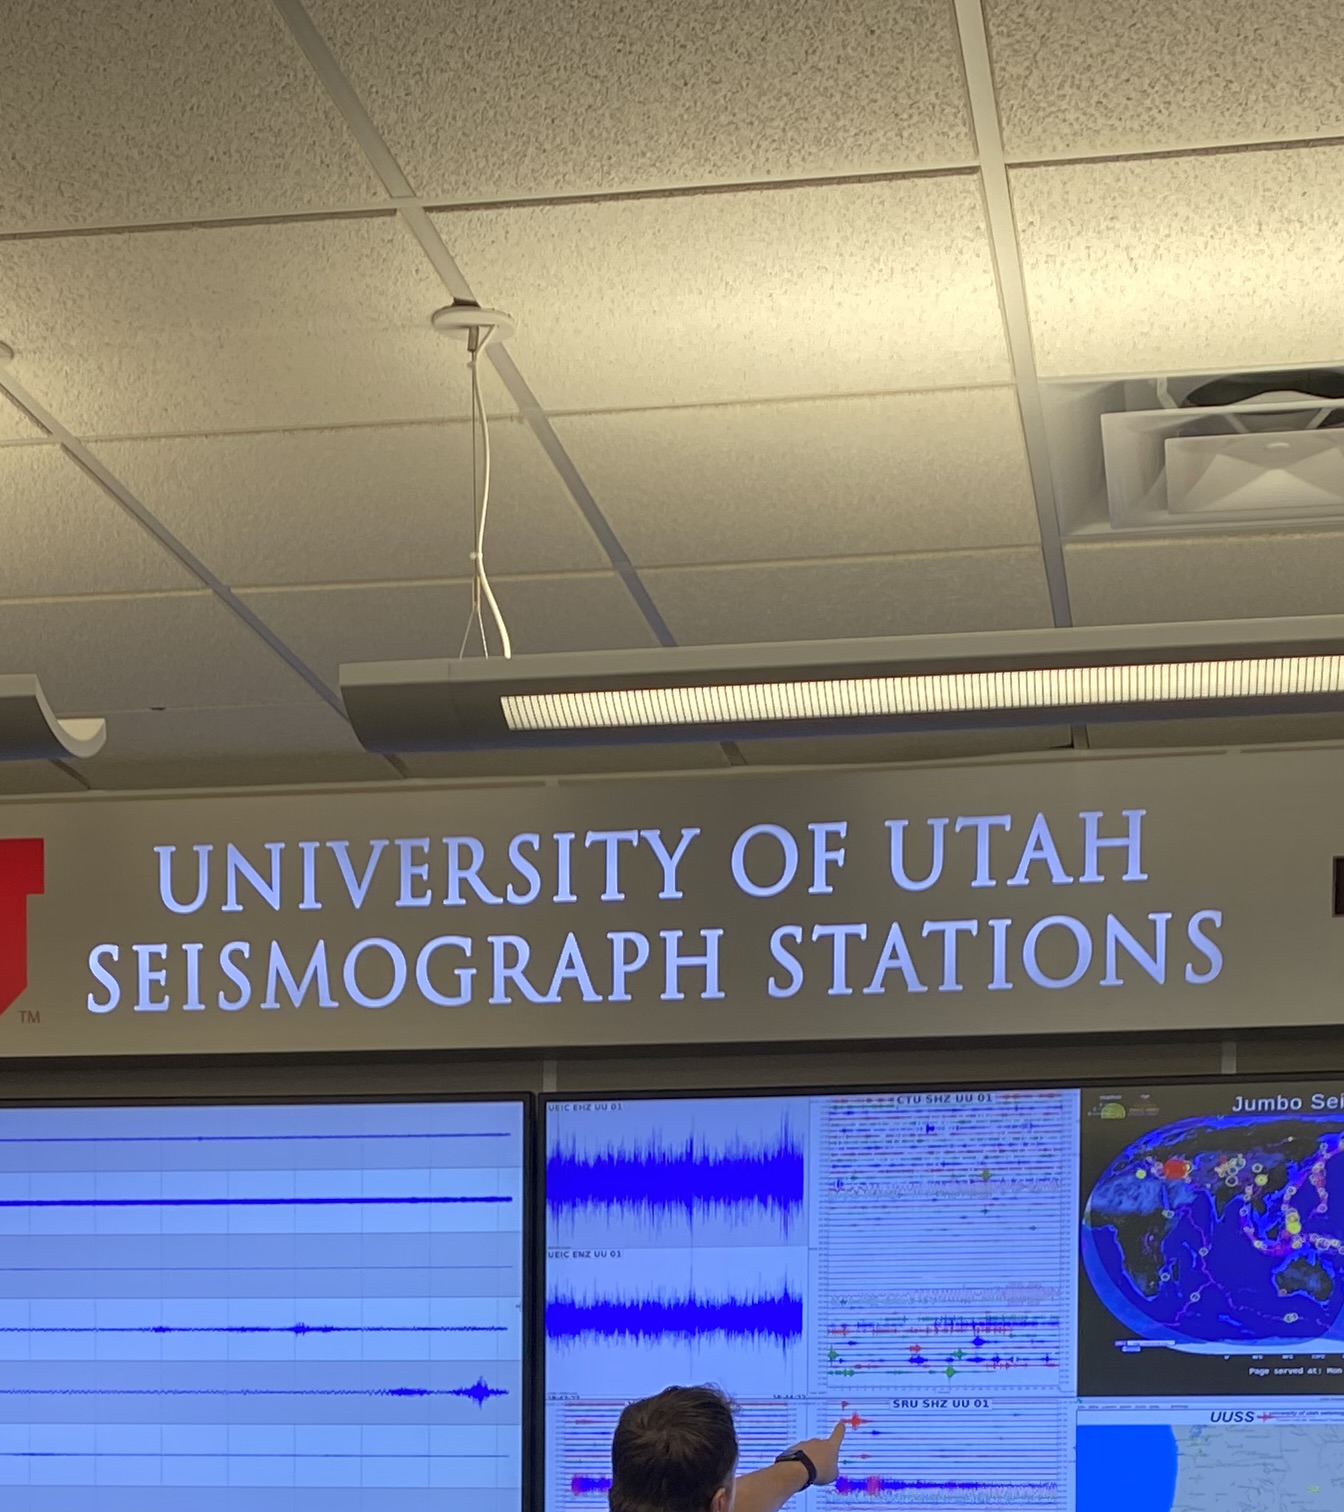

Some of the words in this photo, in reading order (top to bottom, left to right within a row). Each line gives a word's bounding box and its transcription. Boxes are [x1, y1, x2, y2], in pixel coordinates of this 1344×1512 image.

[152, 824, 702, 915] UNIVERSITY
[731, 820, 848, 898] OF
[884, 808, 1149, 892] UTAH
[86, 927, 726, 1014] SEISMOGRAPH
[767, 909, 1224, 998] STATIONS
[19, 1010, 41, 1024] TM
[897, 1094, 922, 1105] CTU
[956, 1094, 973, 1103] UU
[977, 1093, 992, 1102] 01
[1231, 1093, 1302, 1113] Jumbo
[1249, 1367, 1269, 1376] Page
[1274, 1367, 1303, 1375] served
[893, 1399, 917, 1409] SRU
[922, 1399, 947, 1409] SHZ
[952, 1399, 969, 1408] UU
[973, 1399, 989, 1408] 01
[1210, 1411, 1255, 1423] UUSS
